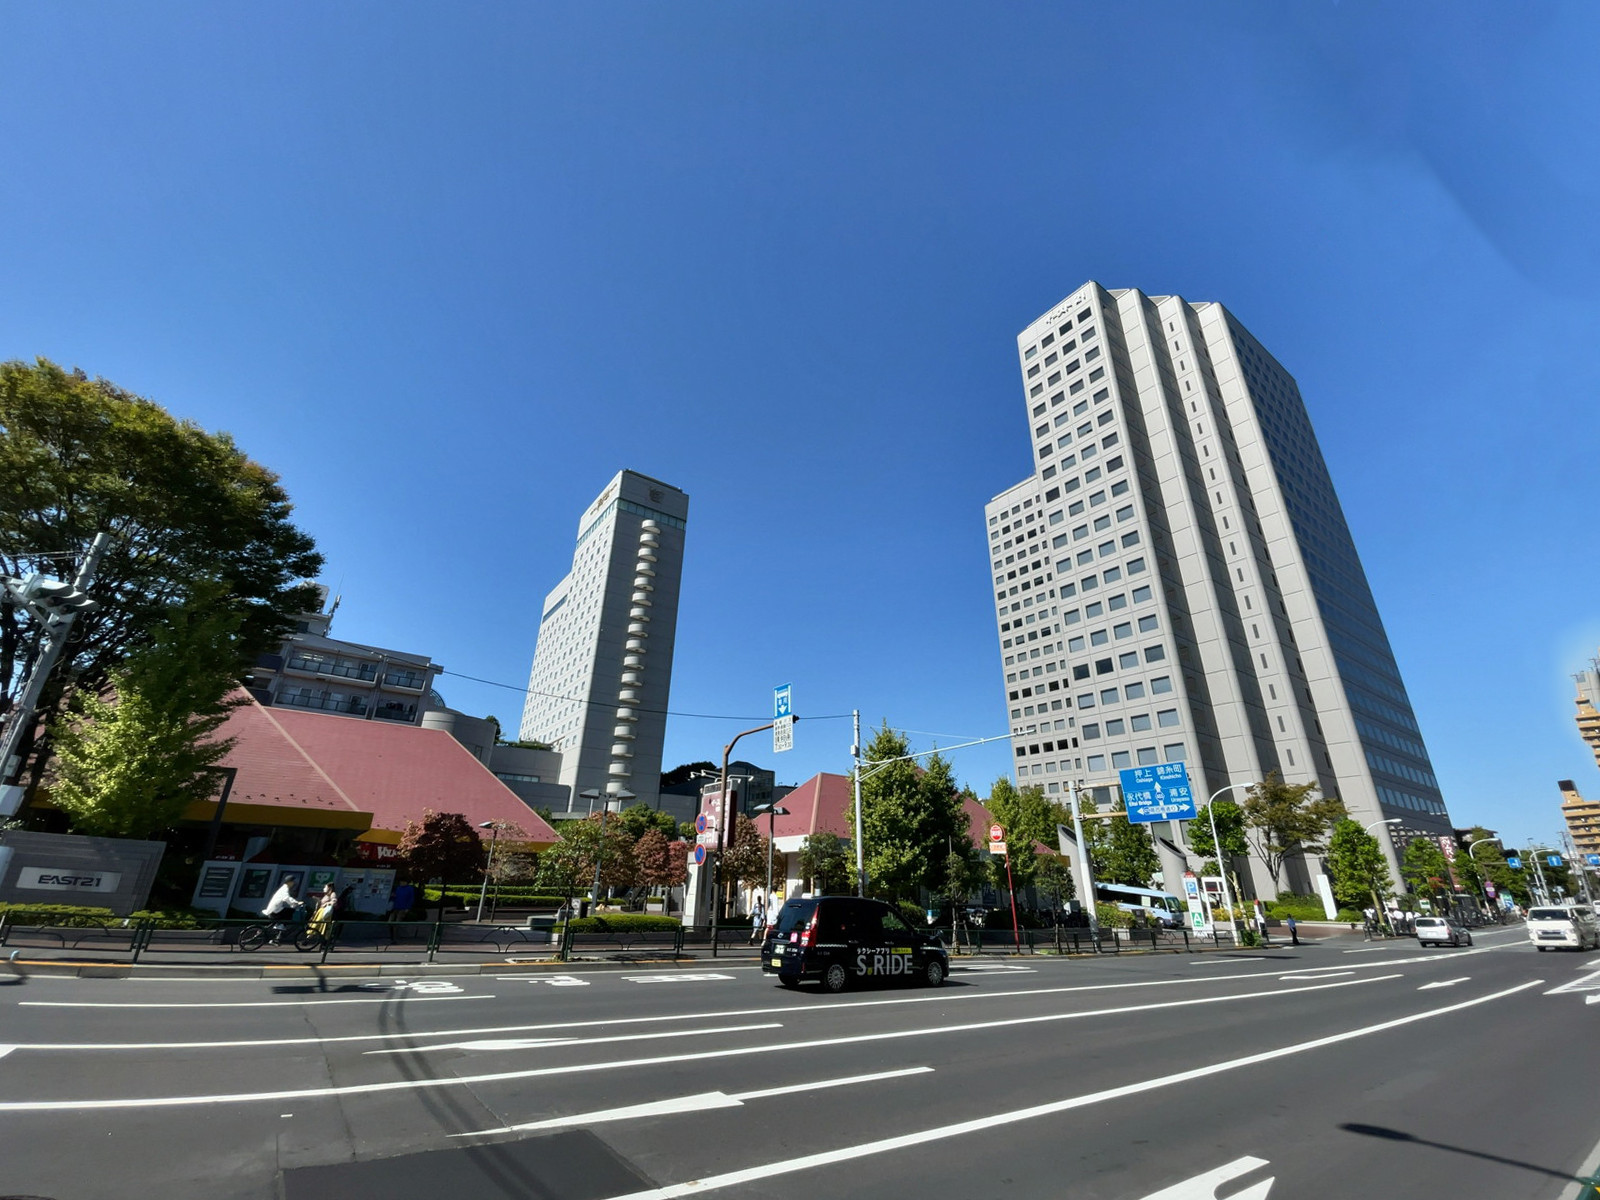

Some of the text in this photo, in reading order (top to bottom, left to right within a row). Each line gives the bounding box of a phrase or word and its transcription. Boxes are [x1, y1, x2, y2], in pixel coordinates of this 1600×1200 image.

[1187, 882, 1195, 892] P
[856, 947, 890, 955] タクシーアプリ
